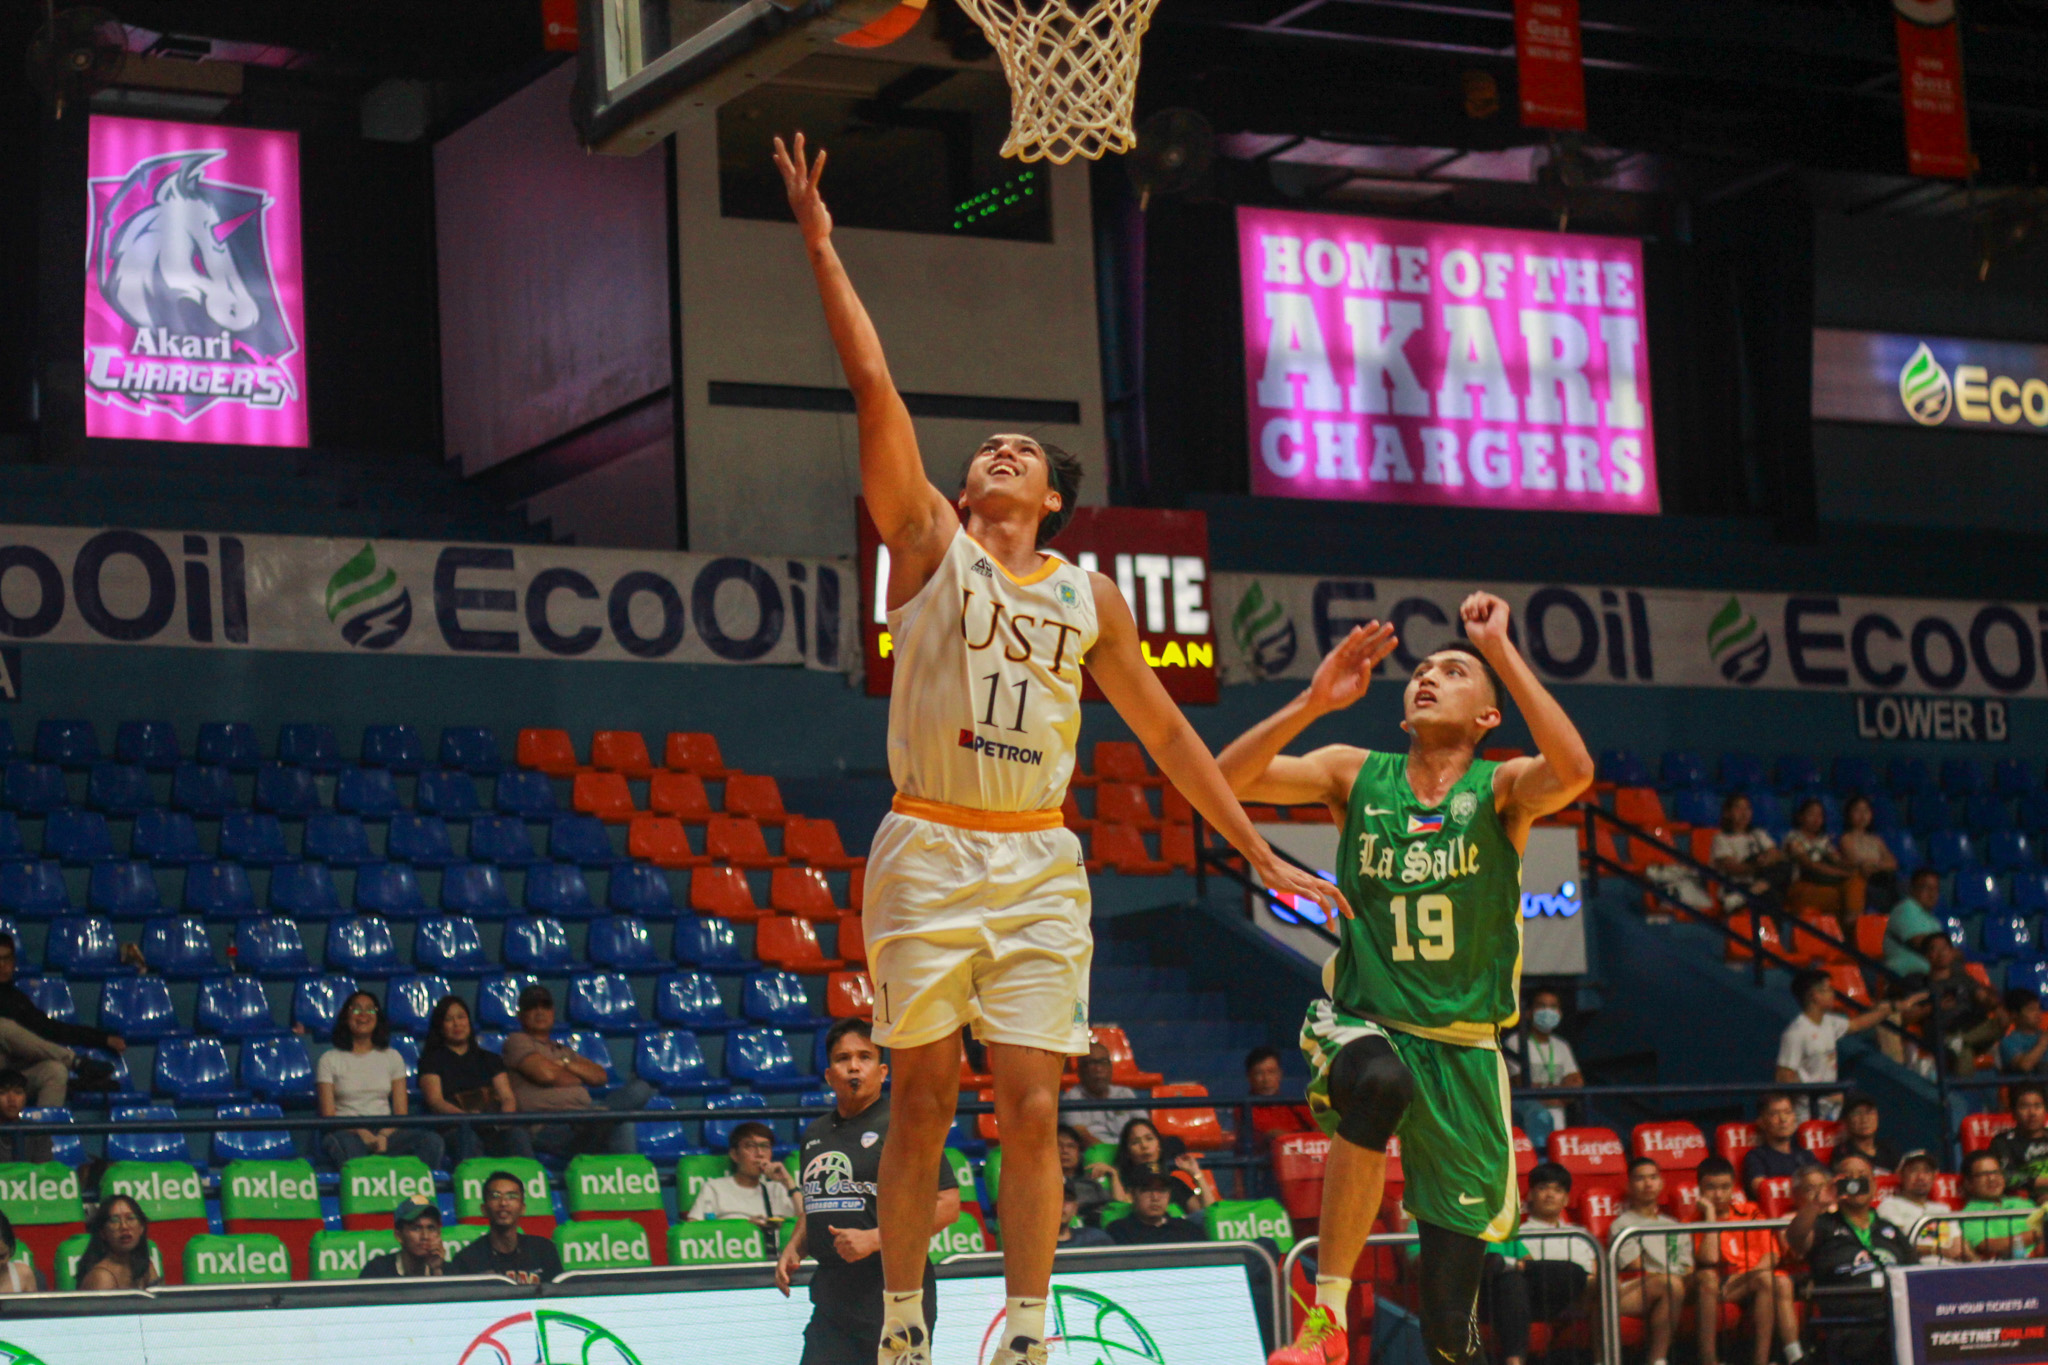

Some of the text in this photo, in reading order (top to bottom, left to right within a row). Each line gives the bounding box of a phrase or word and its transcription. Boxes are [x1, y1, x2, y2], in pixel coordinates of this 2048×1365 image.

[1261, 235, 1636, 309] HOME OF THE
[131, 327, 232, 360] Akari
[1257, 292, 1645, 429] AKARI
[1260, 417, 1645, 495] CHARGERS
[434, 547, 839, 666] EcoOil
[960, 587, 1082, 675] UST
[976, 672, 1029, 734] 11
[1857, 697, 2008, 742] LOWER B
[974, 736, 1043, 766] PETRON
[1358, 832, 1480, 883] La Salle
[1390, 894, 1455, 962] 19
[1558, 1135, 1623, 1156] Hanes
[1642, 1130, 1705, 1152] Hanes
[113, 1171, 201, 1200] nxled
[232, 1170, 318, 1200] nxled
[351, 1169, 436, 1198] nxled
[581, 1166, 660, 1195] nxled
[841, 1179, 877, 1196] ECOOI
[929, 1226, 986, 1253] xled
[1217, 1211, 1292, 1240] nxled
[197, 1243, 288, 1274] nxled
[563, 1232, 650, 1264] nxled
[679, 1230, 763, 1260] nxled
[1986, 1298, 2023, 1312] TICKETS
